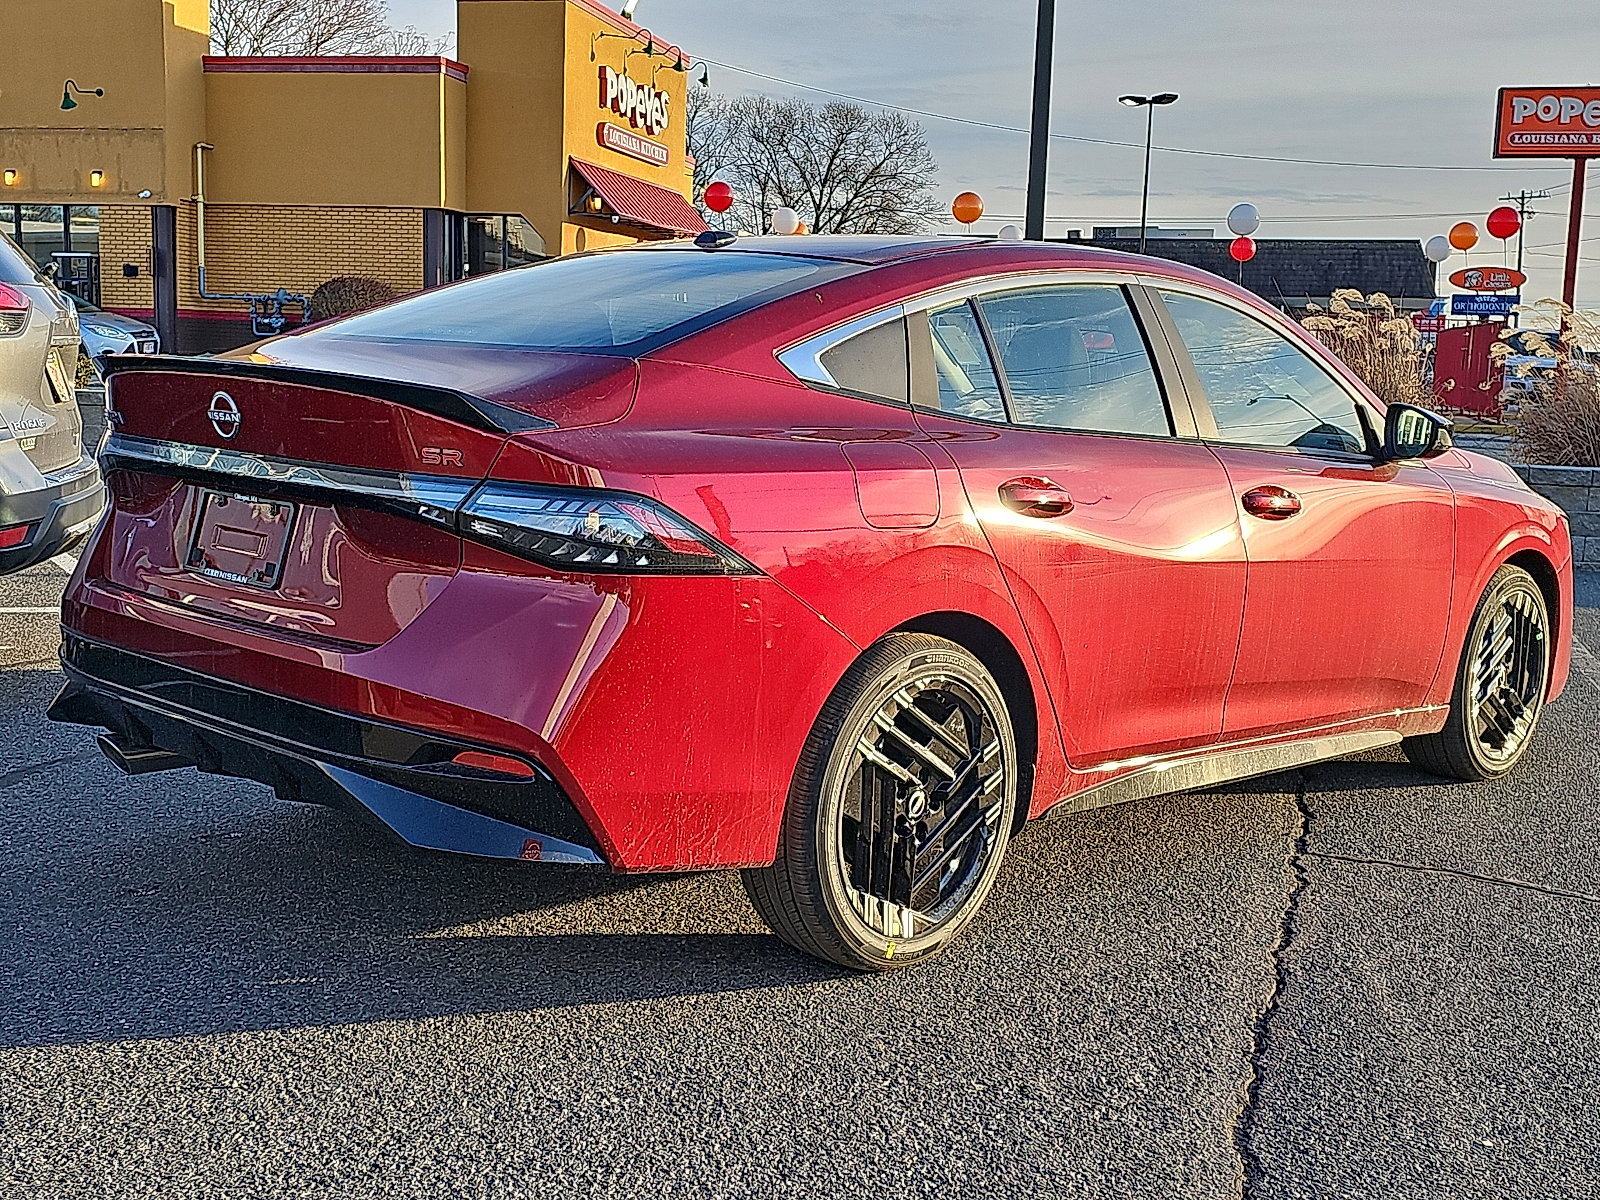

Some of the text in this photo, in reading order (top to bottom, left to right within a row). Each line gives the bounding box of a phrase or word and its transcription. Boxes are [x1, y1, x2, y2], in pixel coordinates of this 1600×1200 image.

[1513, 134, 1588, 144] LOUISIANA
[208, 410, 241, 423] NISSAN
[12, 418, 46, 431] ROGUE
[421, 447, 464, 467] SR
[219, 570, 248, 584] NISSAN
